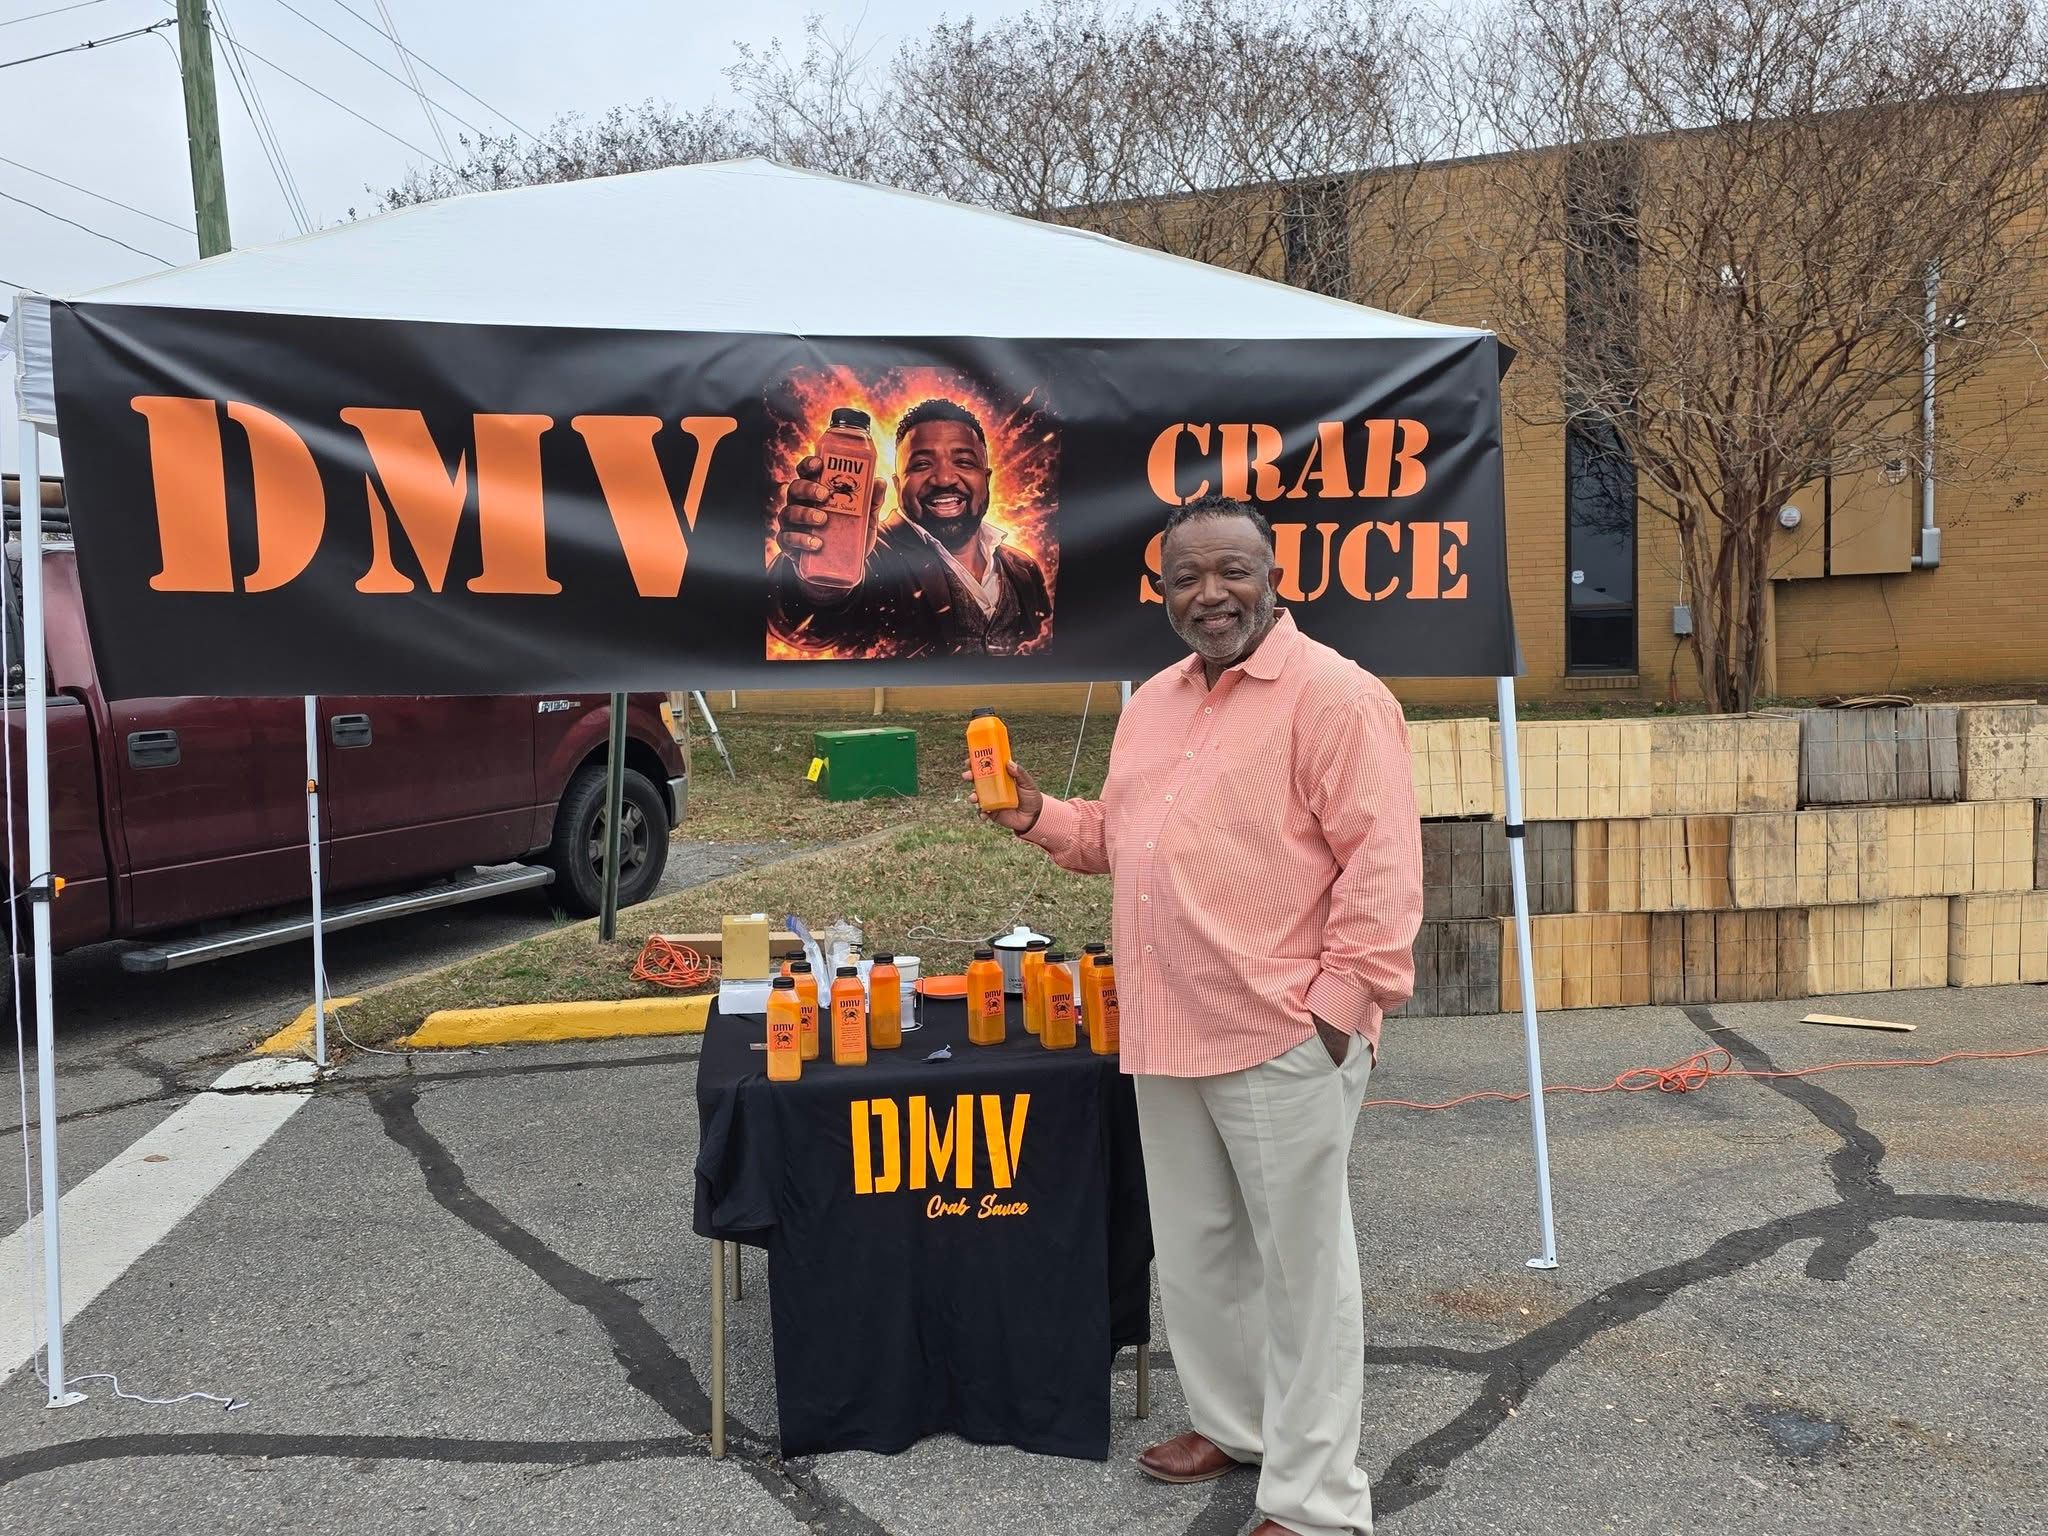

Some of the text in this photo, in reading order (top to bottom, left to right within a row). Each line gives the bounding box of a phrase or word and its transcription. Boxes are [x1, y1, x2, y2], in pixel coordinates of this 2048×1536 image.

[827, 456, 864, 475] DMV
[1147, 419, 1429, 506] CRAB
[131, 395, 738, 598] DMV
[1139, 521, 1468, 603] UCE
[974, 747, 993, 758] DMV
[984, 989, 1002, 999] DMV
[1052, 993, 1071, 1003] DMV
[800, 1006, 813, 1014] MV
[840, 999, 860, 1008] DMV
[773, 1023, 794, 1032] DMV
[851, 1093, 1031, 1194] DMV
[926, 1193, 1030, 1219] Crab Sauce
